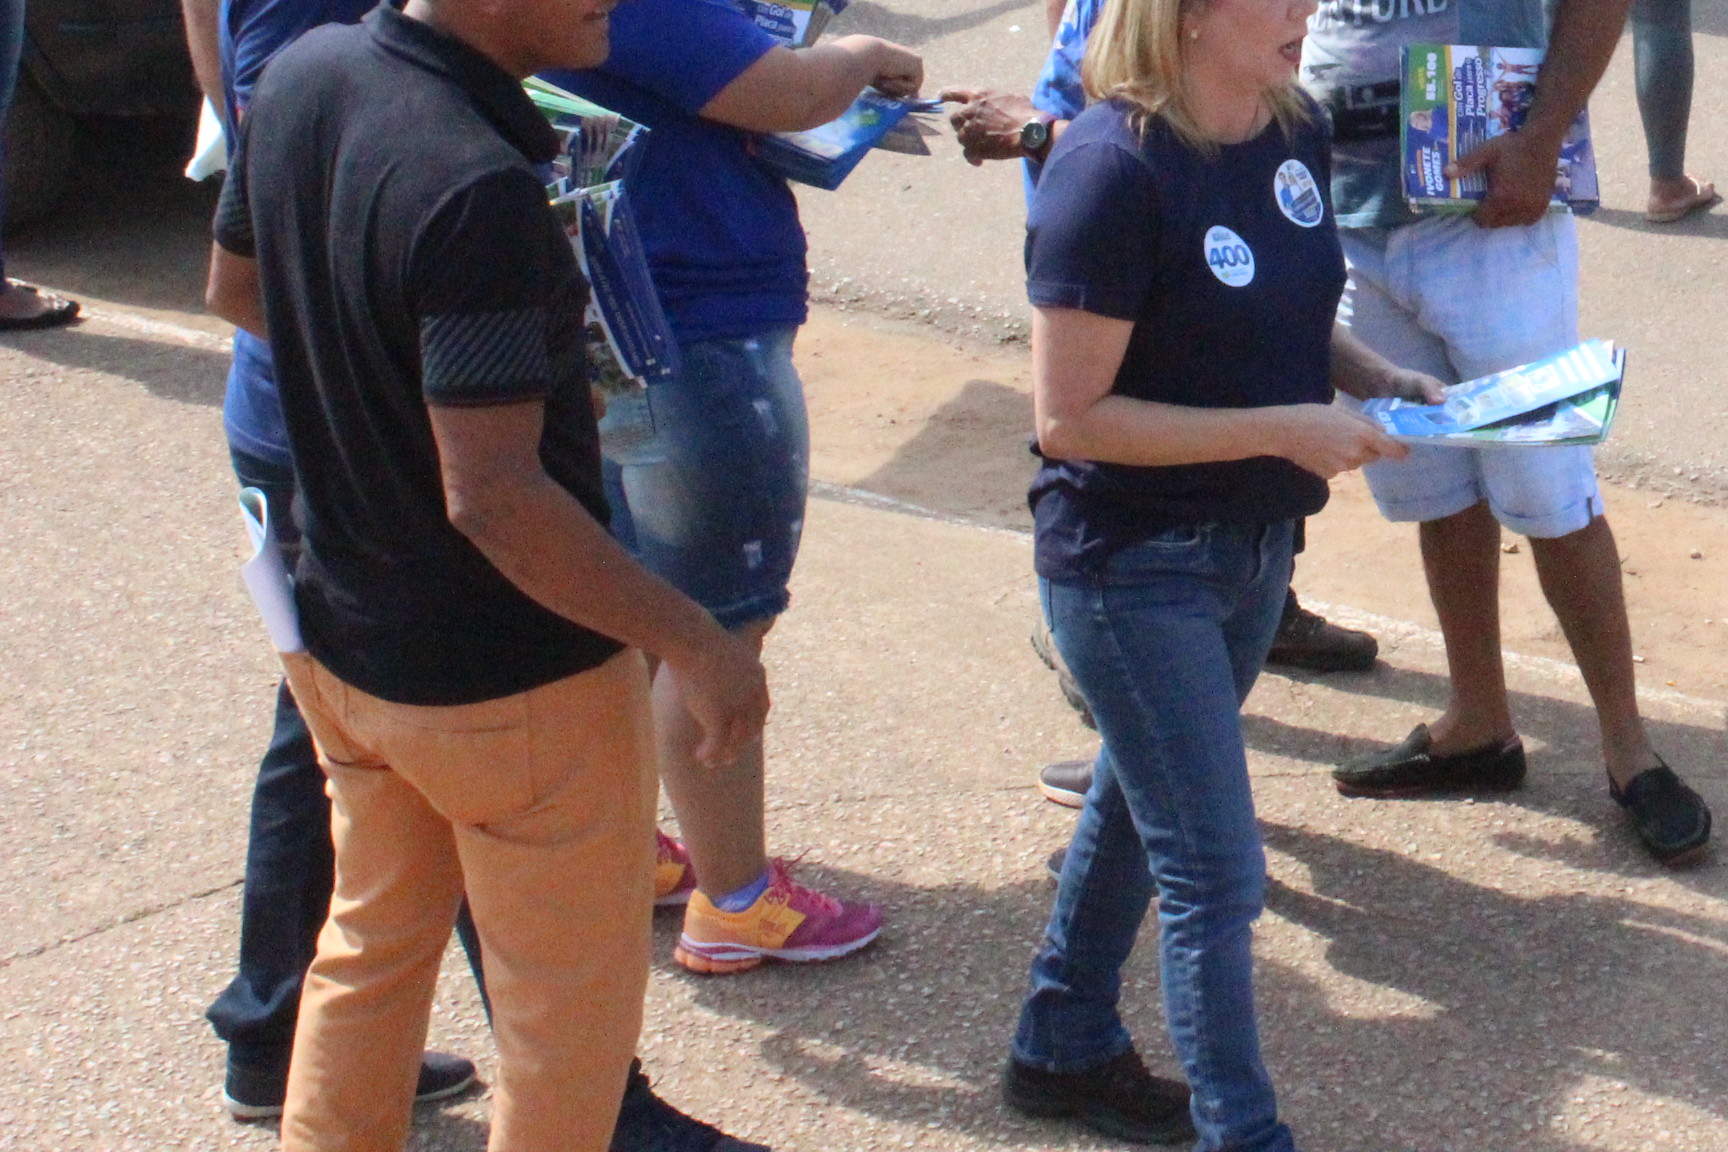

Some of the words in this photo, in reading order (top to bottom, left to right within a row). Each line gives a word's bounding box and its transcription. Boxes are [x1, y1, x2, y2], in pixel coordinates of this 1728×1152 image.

[754, 14, 779, 30] Placa
[1454, 79, 1463, 101] Gol
[1465, 84, 1475, 117] Placa
[1475, 56, 1487, 117] Progresso
[1422, 147, 1435, 196] IVONETE
[1432, 151, 1444, 192] GOMES
[1209, 244, 1250, 269] 400
